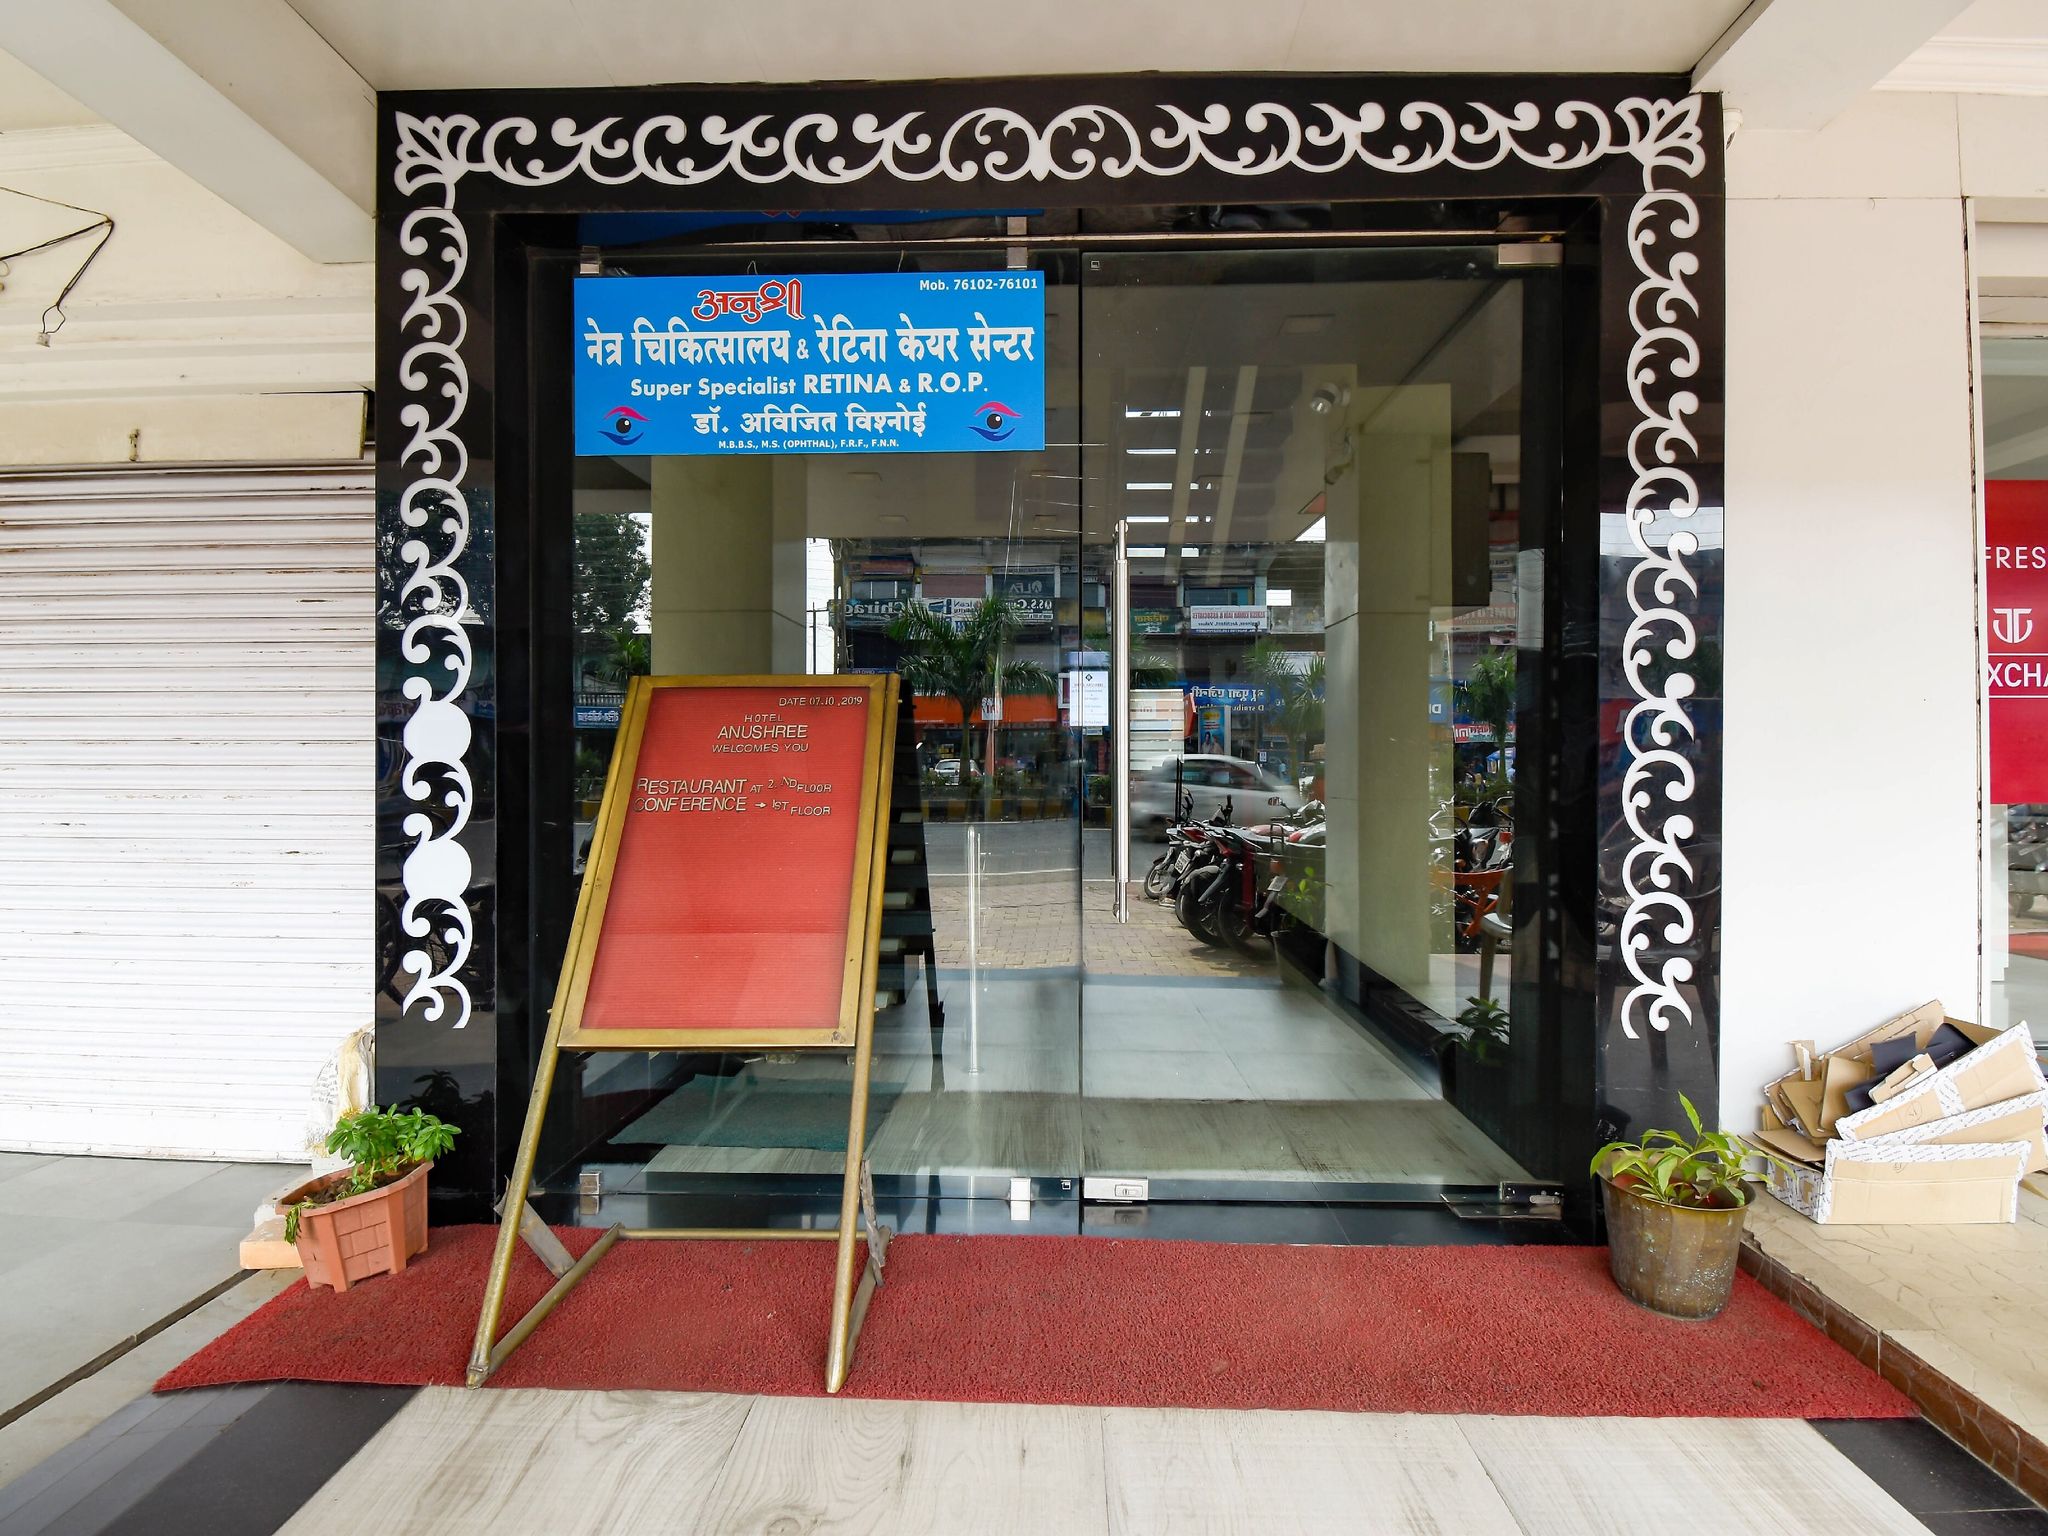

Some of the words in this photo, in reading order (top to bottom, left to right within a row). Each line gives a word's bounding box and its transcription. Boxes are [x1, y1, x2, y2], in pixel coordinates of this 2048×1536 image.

[919, 279, 949, 291] Mob.
[953, 278, 1038, 291] 76102-76101
[691, 278, 806, 324] अनुश्री
[583, 317, 624, 366] नेत्र
[630, 316, 791, 366] चिकित्सालय
[796, 338, 810, 360] &
[813, 313, 889, 364] रेटिना
[895, 312, 960, 362] केयर
[967, 311, 1035, 362] सेन्टर
[630, 378, 692, 401] Super
[698, 375, 797, 400] Specialist
[803, 373, 893, 394] RETINA
[899, 378, 911, 393] &
[918, 372, 988, 393] R.O.P.
[691, 404, 729, 434] डॉ.
[739, 403, 838, 433] अविजित
[844, 401, 927, 437] विश्नोई
[718, 440, 759, 449] M.B.B.S.,
[761, 440, 780, 448] M.S.
[783, 439, 838, 449] (OPHTHAL),
[840, 439, 869, 448] F.R.F.,
[871, 439, 900, 447] F.N.N.
[779, 698, 807, 707] DATE
[744, 713, 783, 723] HOTEL
[717, 724, 809, 739] ANUSHREE
[711, 743, 779, 753] WELCOMES
[783, 743, 809, 752] YOU
[637, 777, 748, 795] RESTAURANT
[749, 784, 764, 793] AT
[780, 776, 798, 787] ND
[796, 784, 832, 794] FLOOR
[632, 796, 748, 812] CONFERENCE
[790, 806, 832, 816] FLOOR
